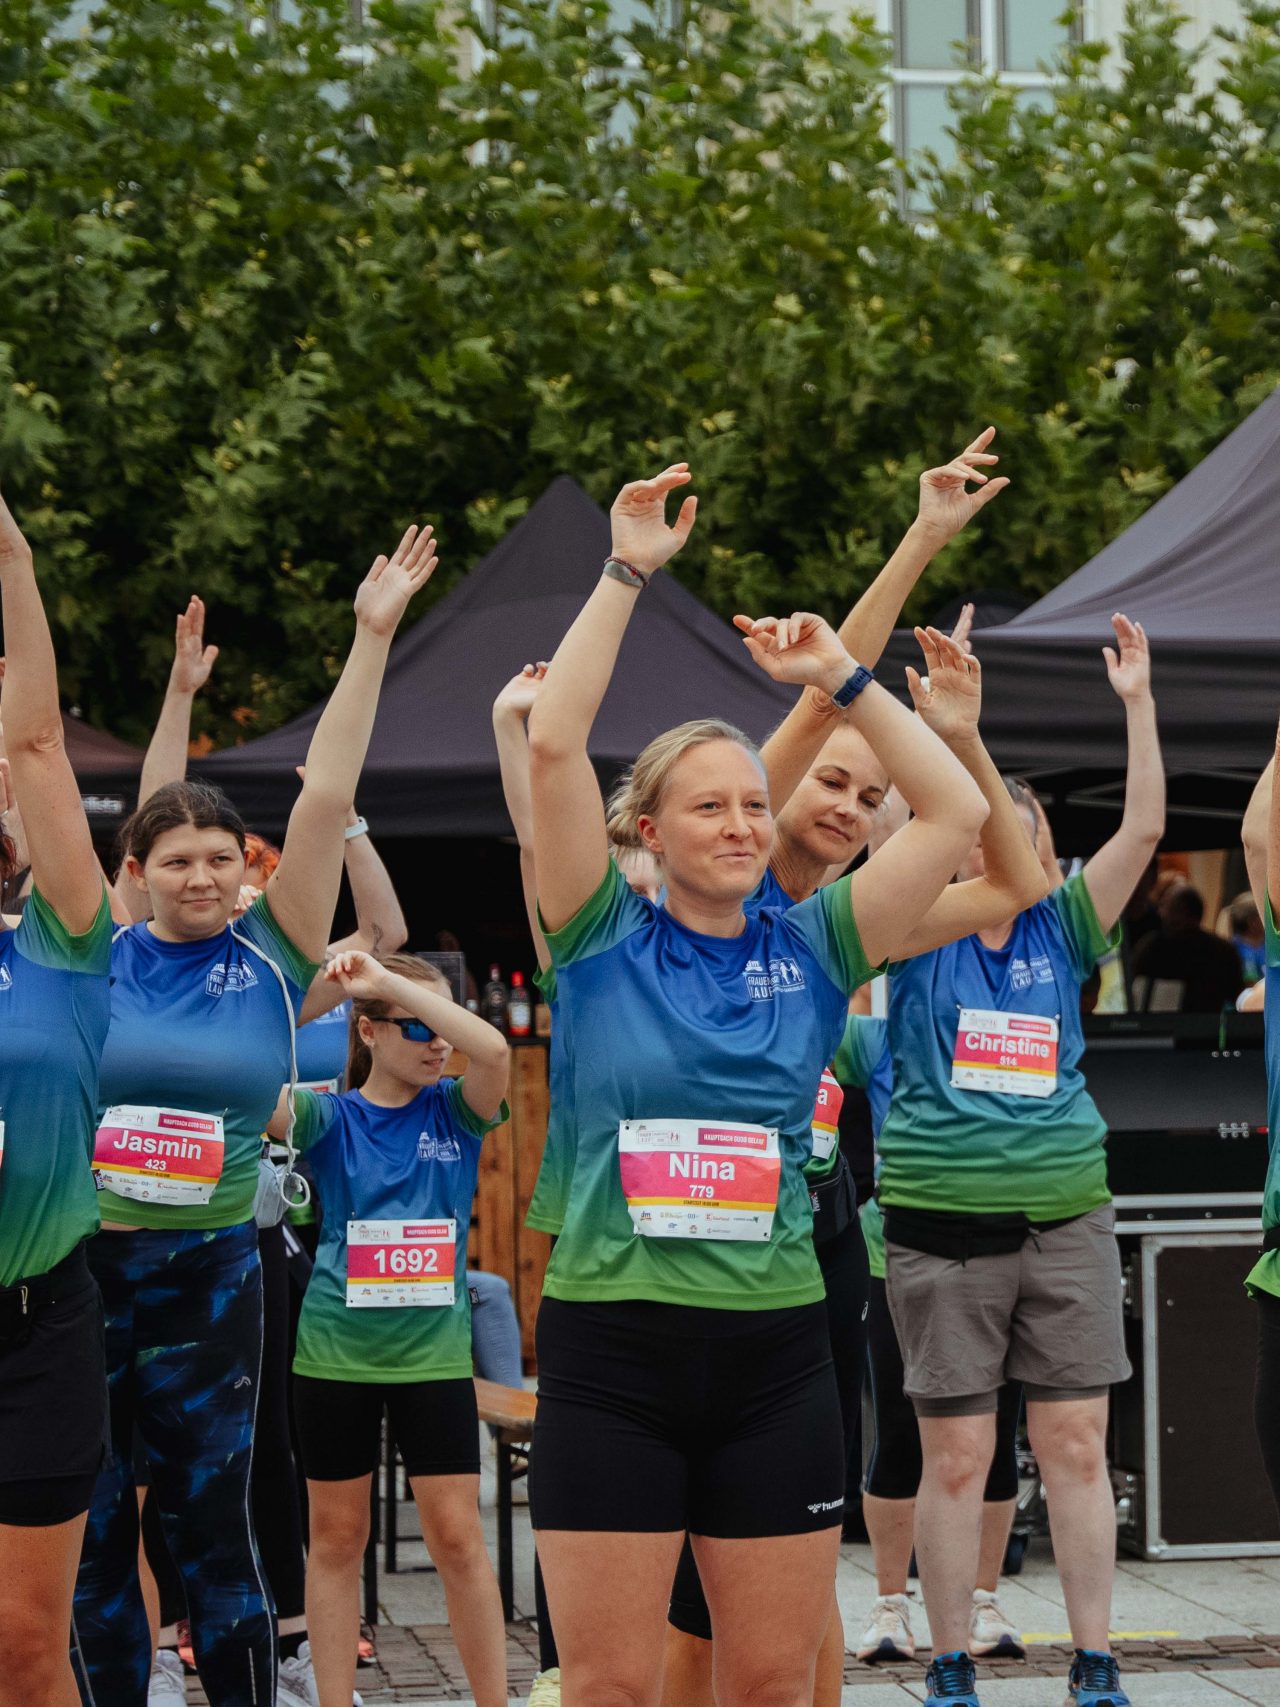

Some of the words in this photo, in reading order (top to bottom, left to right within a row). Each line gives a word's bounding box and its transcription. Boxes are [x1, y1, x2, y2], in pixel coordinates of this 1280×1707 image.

[965, 1032, 1050, 1058] Christine
[113, 1130, 202, 1160] Jasmin
[145, 1159, 167, 1171] 423
[669, 1153, 735, 1181] Nina
[689, 1185, 714, 1198] 779
[373, 1248, 438, 1274] 1692
